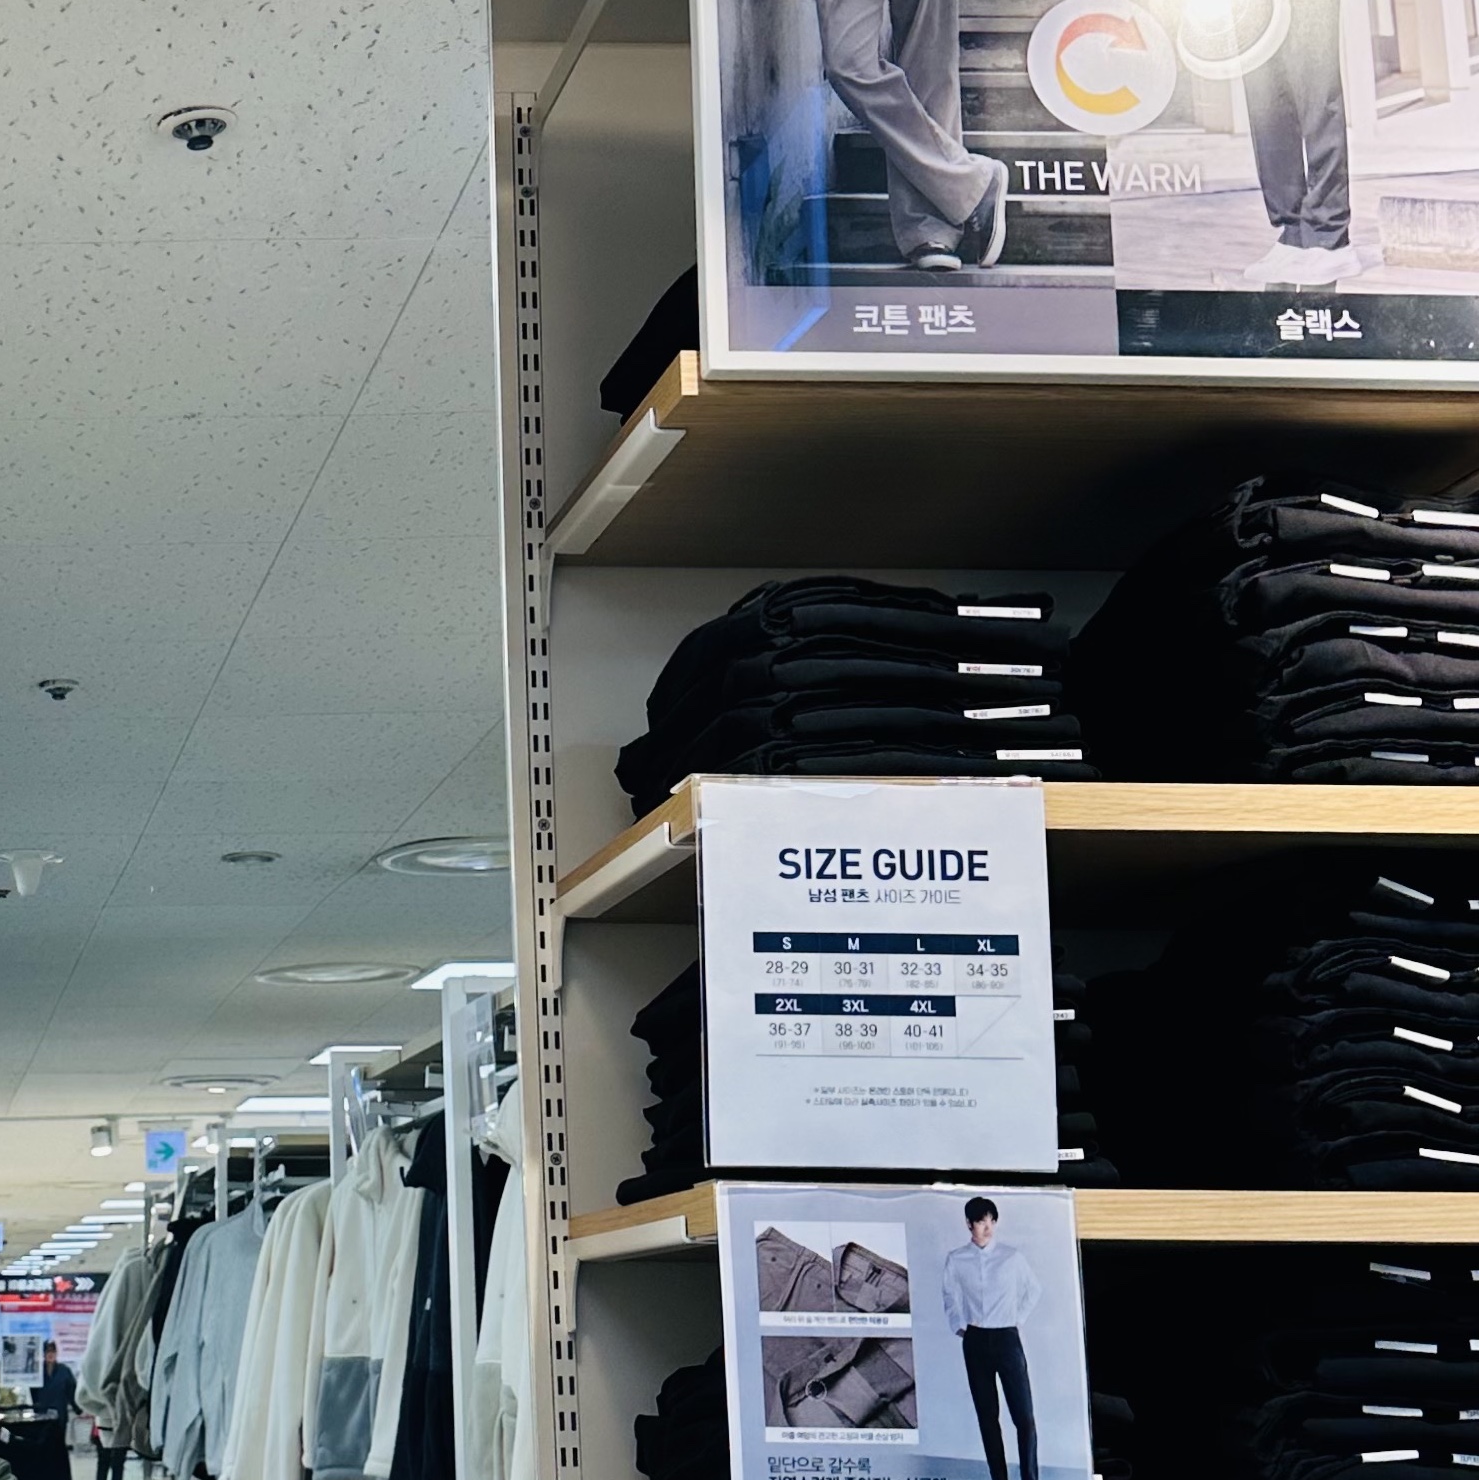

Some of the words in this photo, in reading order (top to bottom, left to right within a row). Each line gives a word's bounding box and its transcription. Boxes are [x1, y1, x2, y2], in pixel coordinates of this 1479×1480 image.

[1015, 160, 1085, 192] THE
[1095, 160, 1202, 194] WARM
[852, 304, 912, 337] 코튼
[918, 303, 976, 336] 팬츠
[1275, 307, 1363, 342] 슬랙스
[778, 847, 863, 880] SIZE
[872, 848, 990, 882] GUIDE
[808, 888, 837, 903] 남성
[841, 888, 870, 904] 팬츠
[874, 889, 916, 904] 사이즈
[920, 889, 962, 905] 가이드
[782, 936, 792, 950] S
[847, 938, 860, 951] M
[916, 939, 925, 952] L
[977, 939, 995, 953] XL
[765, 960, 809, 975] 28-29
[834, 961, 875, 976] 30-31
[901, 962, 942, 977] 32-33
[967, 963, 1009, 978] 34-35
[775, 998, 802, 1012] 2XL
[842, 999, 869, 1013] 3XL
[909, 1000, 937, 1014] 4XL
[768, 1022, 812, 1037] 36-37
[835, 1023, 878, 1037] 38-39
[903, 1024, 944, 1038] 40-41
[828, 1457, 872, 1474] 갈수록
